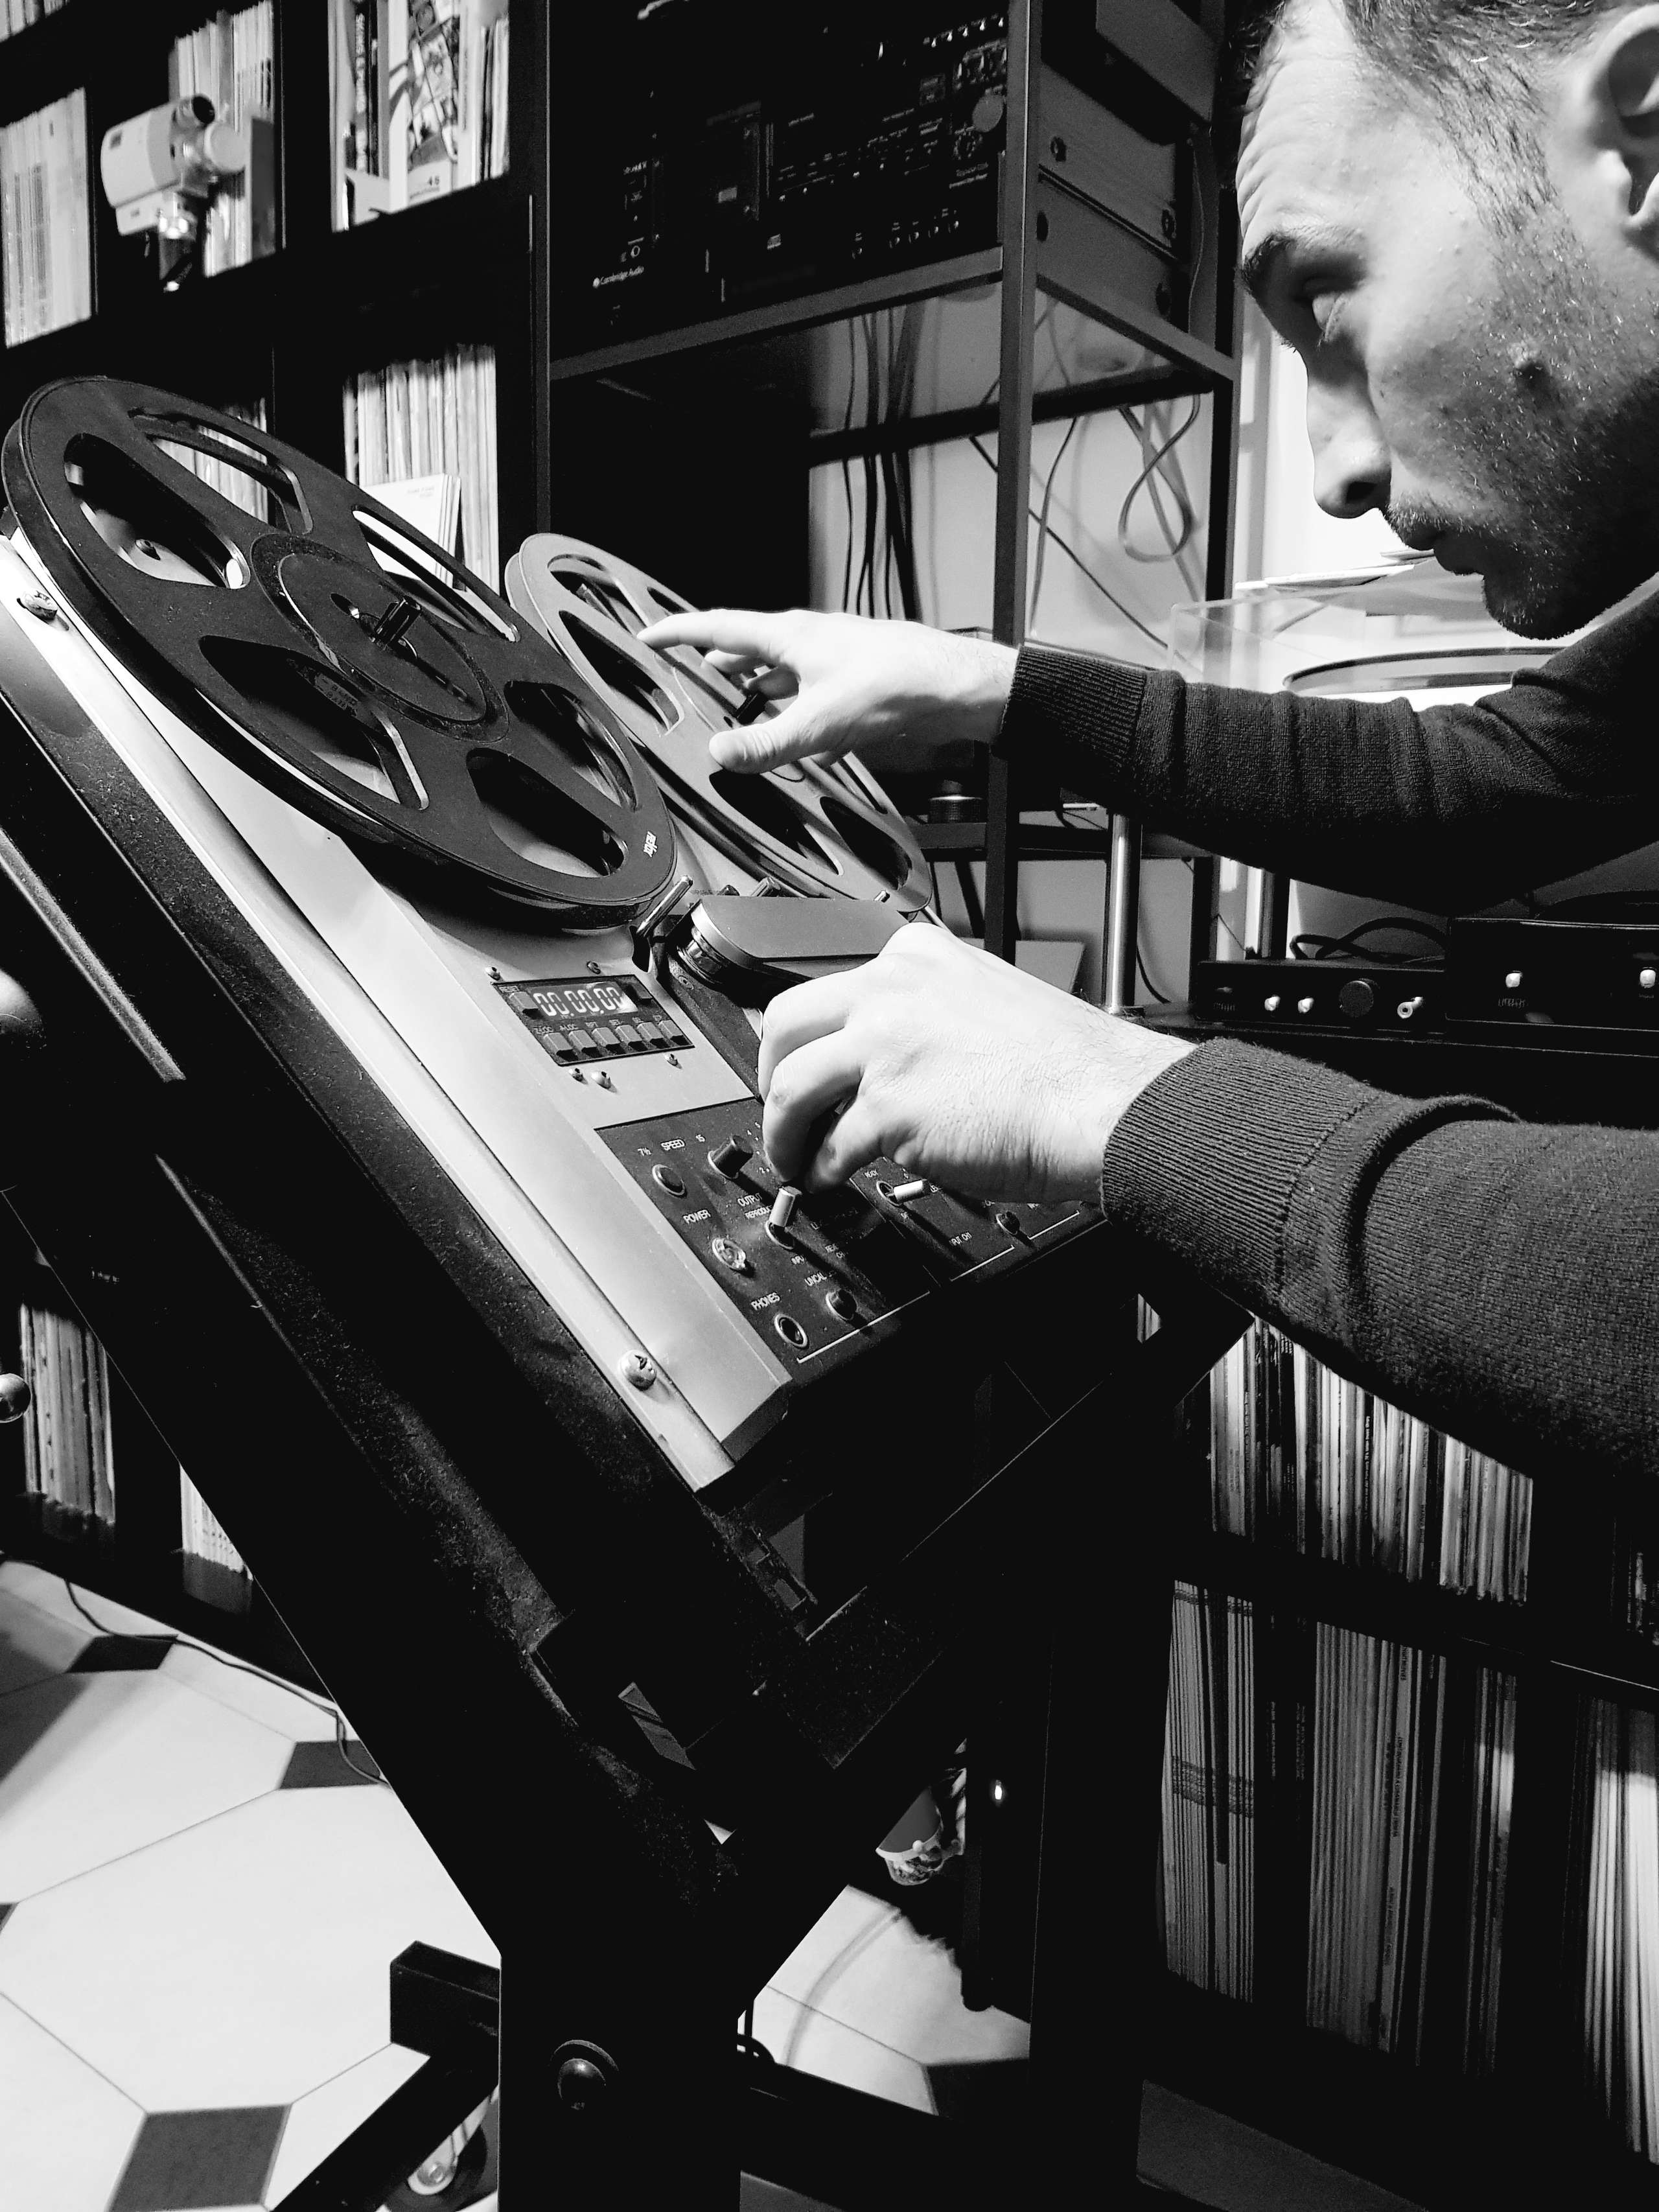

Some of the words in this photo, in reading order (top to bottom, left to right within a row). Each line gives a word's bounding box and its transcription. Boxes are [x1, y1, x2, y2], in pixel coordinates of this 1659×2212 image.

[660, 1139, 686, 1151] SPEED
[695, 1134, 706, 1143] 15
[737, 1193, 763, 1207] OUTPUT
[682, 1208, 712, 1224] POWER
[745, 1204, 773, 1219] REPRODUC
[804, 1272, 828, 1287] UNCAL
[750, 1292, 781, 1310] PHONES
